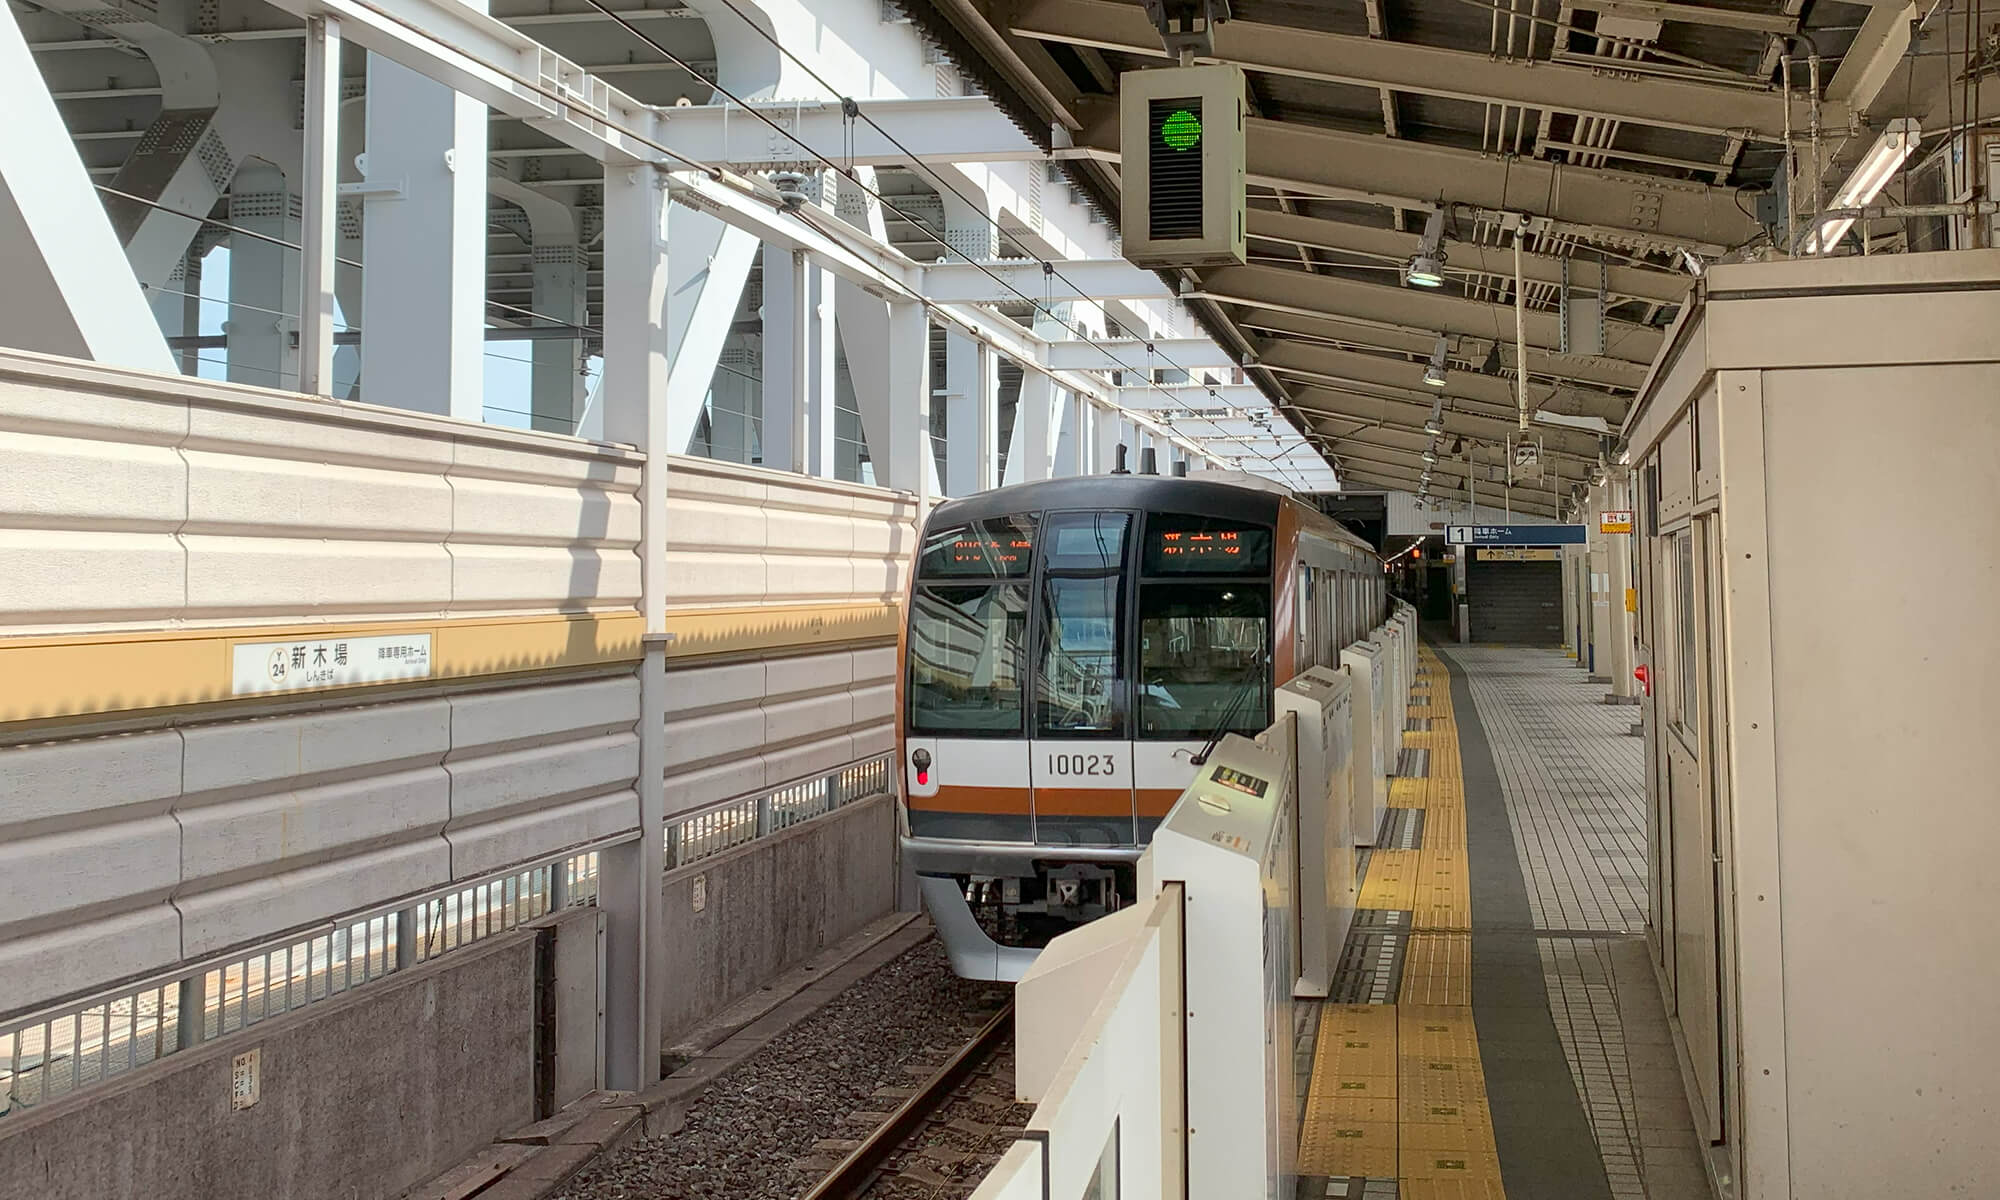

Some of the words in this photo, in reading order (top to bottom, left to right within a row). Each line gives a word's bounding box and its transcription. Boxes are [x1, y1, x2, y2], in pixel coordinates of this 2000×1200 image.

[1457, 528, 1464, 541] 1
[277, 651, 282, 661] Y
[291, 643, 348, 669] 新木場
[272, 663, 285, 677] 24
[306, 668, 334, 682] しんきば
[1049, 754, 1114, 775] 10023
